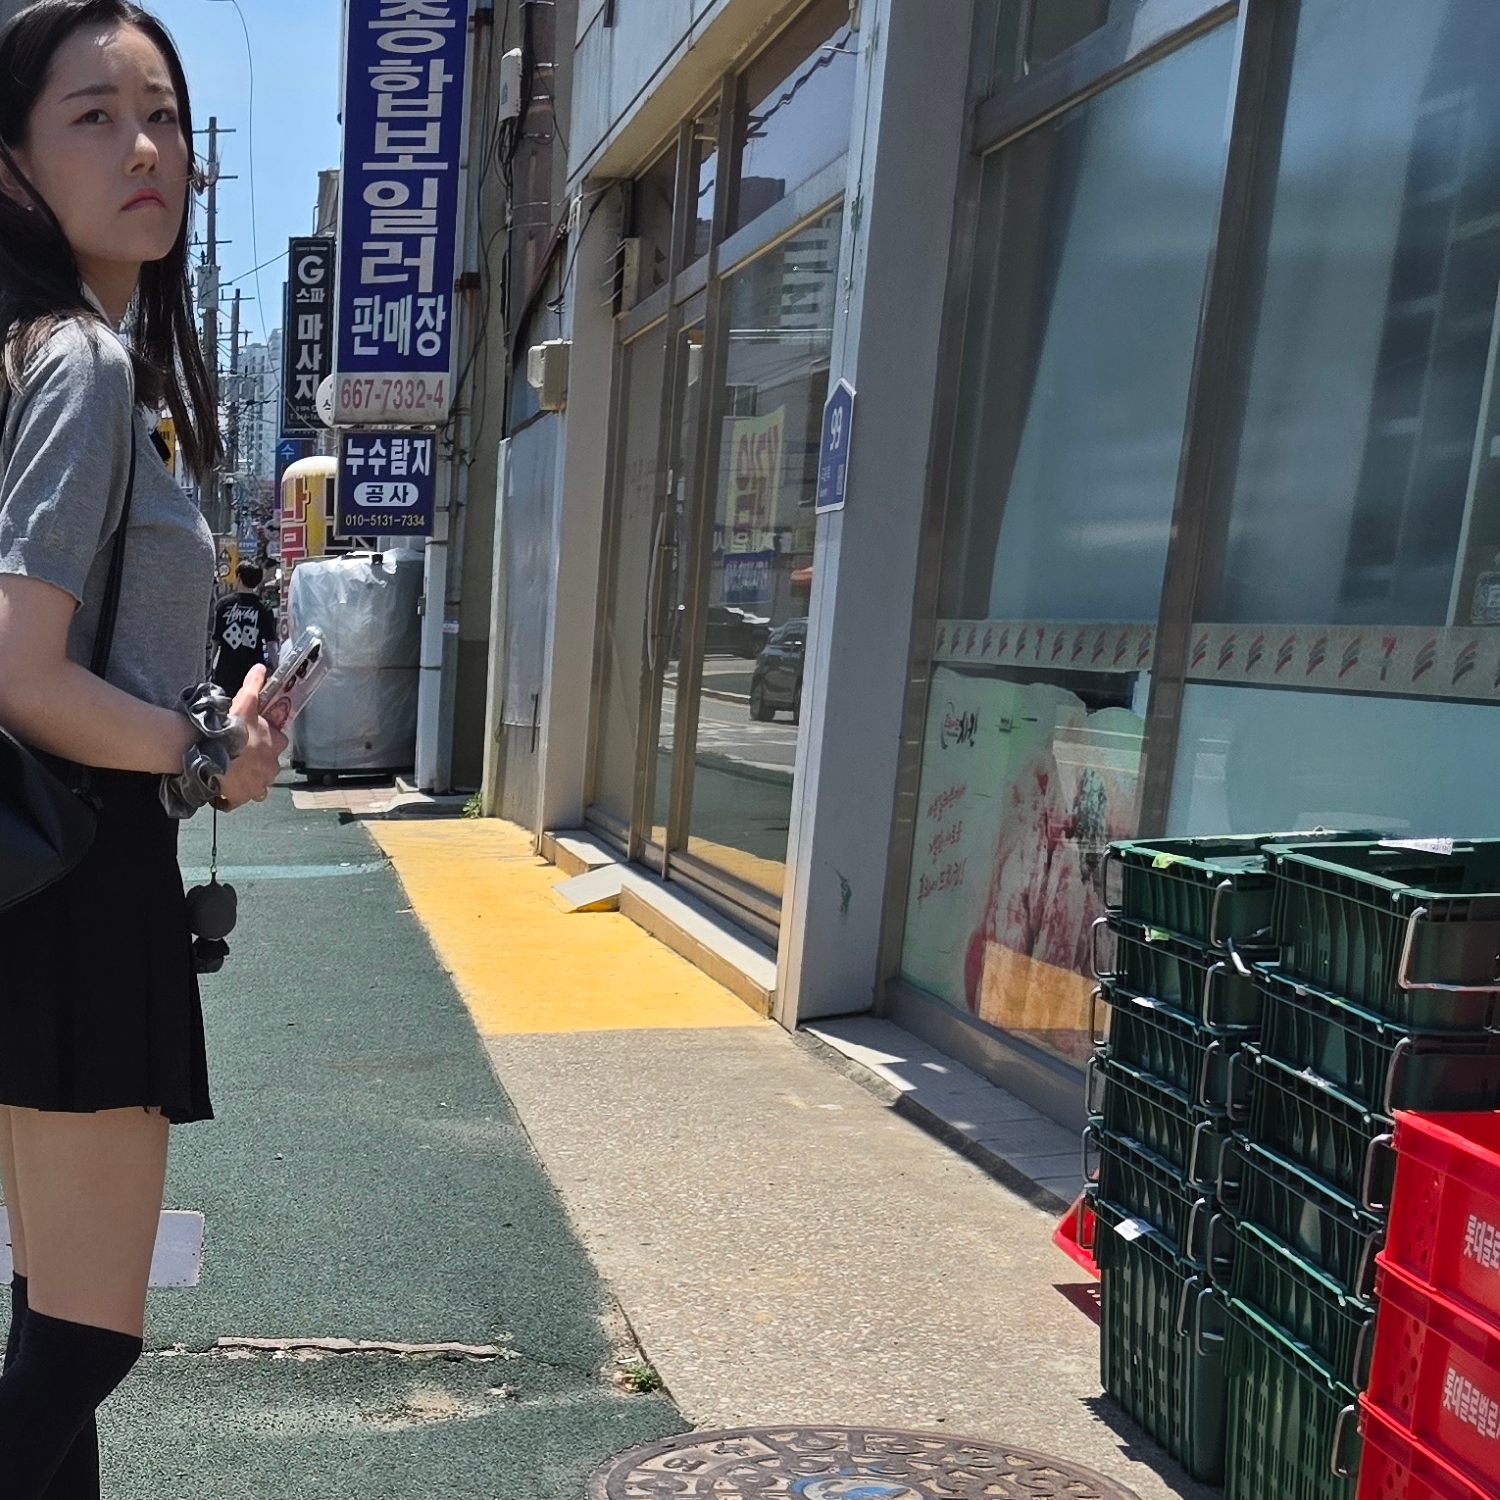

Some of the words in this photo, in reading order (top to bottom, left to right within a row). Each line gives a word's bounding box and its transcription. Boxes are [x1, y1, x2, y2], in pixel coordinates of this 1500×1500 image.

[362, 0, 455, 293] 종합보일러
[297, 255, 325, 285] G
[296, 287, 325, 303] 스파
[352, 294, 446, 357] 판매장
[295, 313, 323, 401] 마사지
[340, 379, 444, 409] 667-7332-4
[830, 405, 843, 451] 99
[346, 438, 431, 476] 누수탐지
[365, 484, 409, 503] 공사
[345, 514, 426, 527] 010-5131-7334
[1443, 1368, 1500, 1440] 롯데글로벌로
